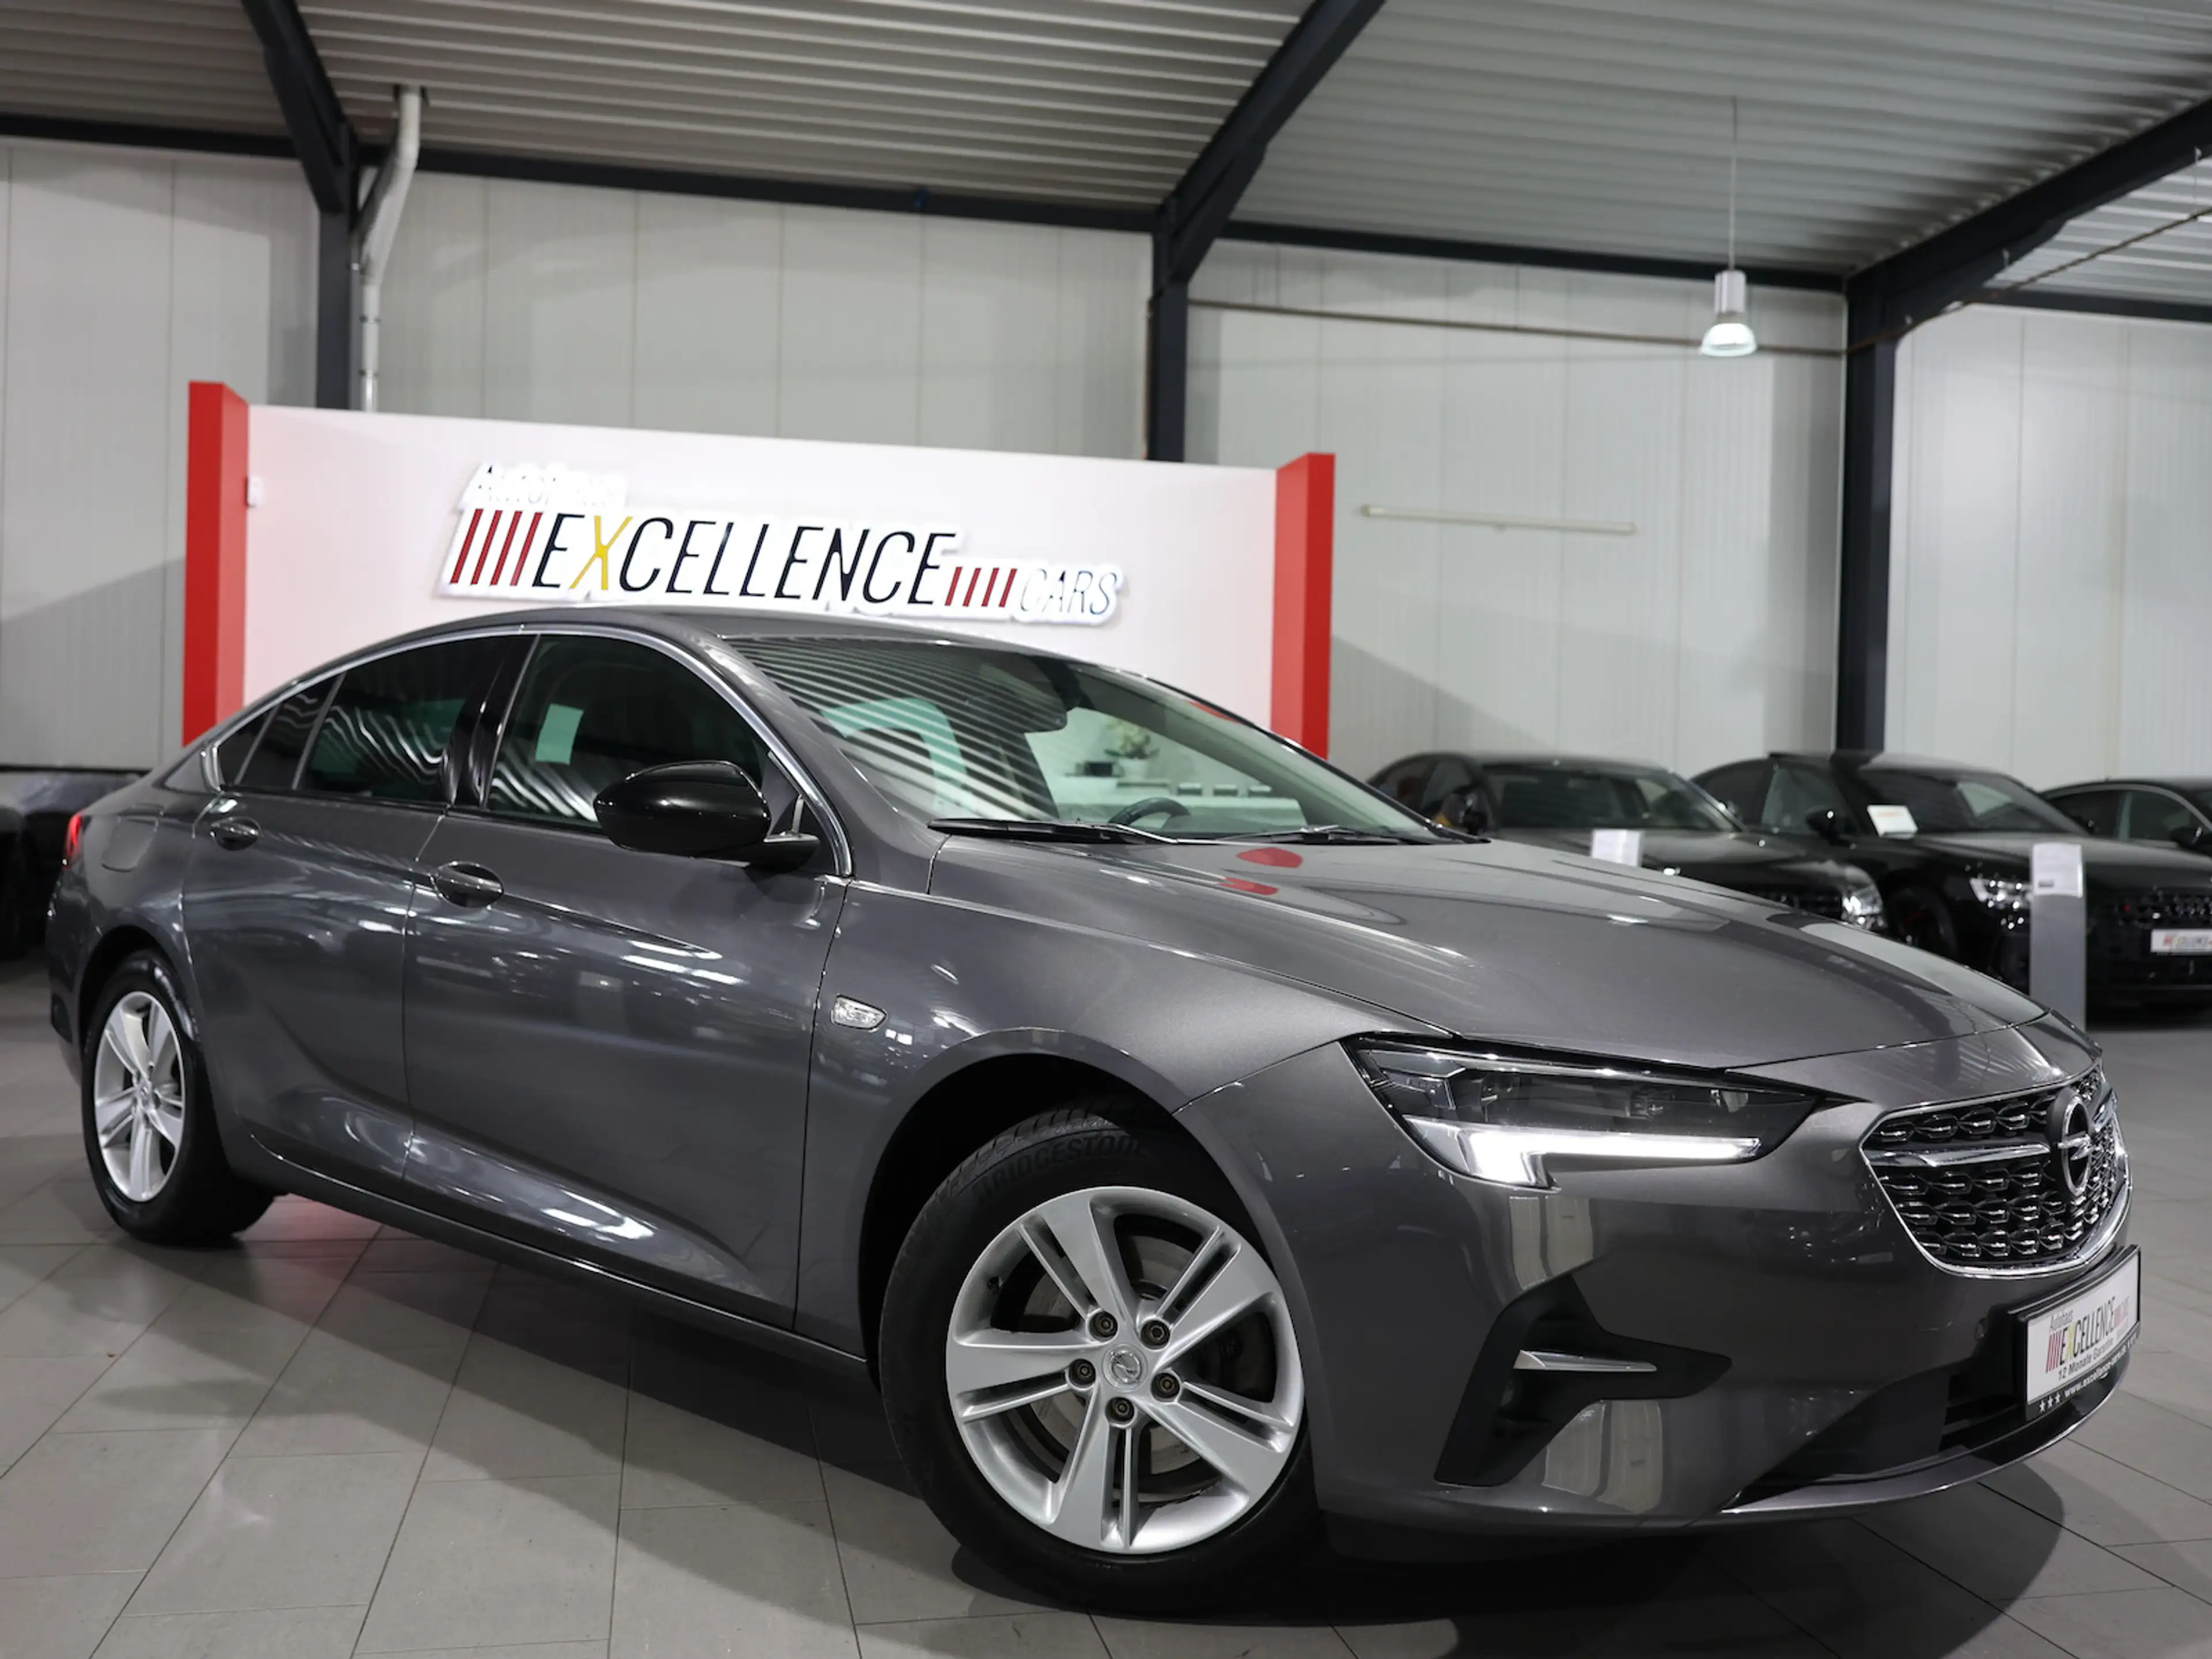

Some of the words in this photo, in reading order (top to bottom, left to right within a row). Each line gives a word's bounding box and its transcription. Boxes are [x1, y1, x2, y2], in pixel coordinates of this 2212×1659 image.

[532, 513, 957, 607] EXCELLENCE
[1020, 567, 1118, 615] CARS
[2059, 1296, 2116, 1366] EXCELLENCE
